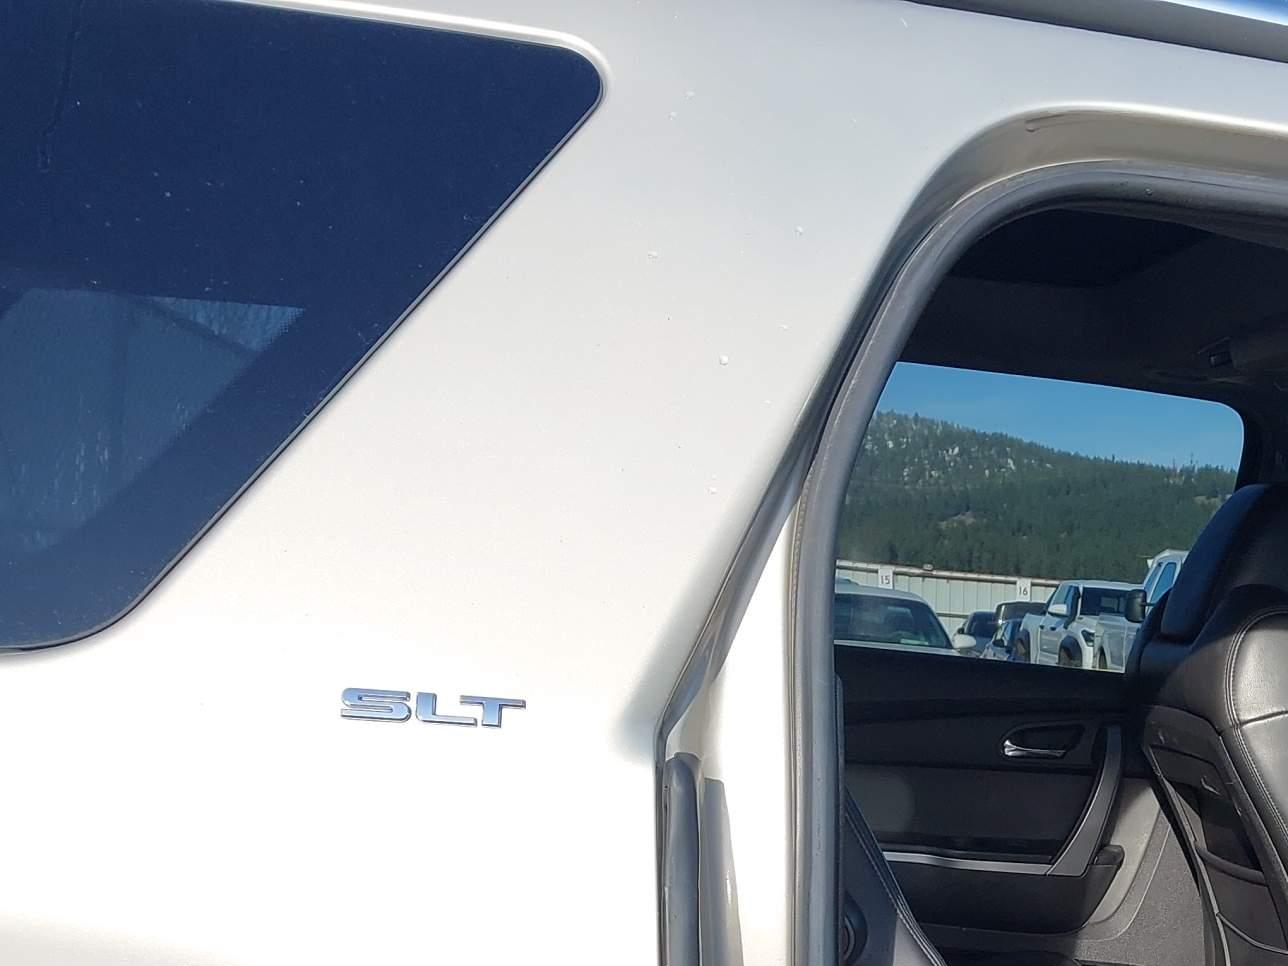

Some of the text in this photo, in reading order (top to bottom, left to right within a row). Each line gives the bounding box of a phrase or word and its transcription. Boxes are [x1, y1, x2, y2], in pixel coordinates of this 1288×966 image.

[880, 575, 890, 585] 15
[1018, 586, 1028, 596] 16
[340, 687, 526, 728] SLT
